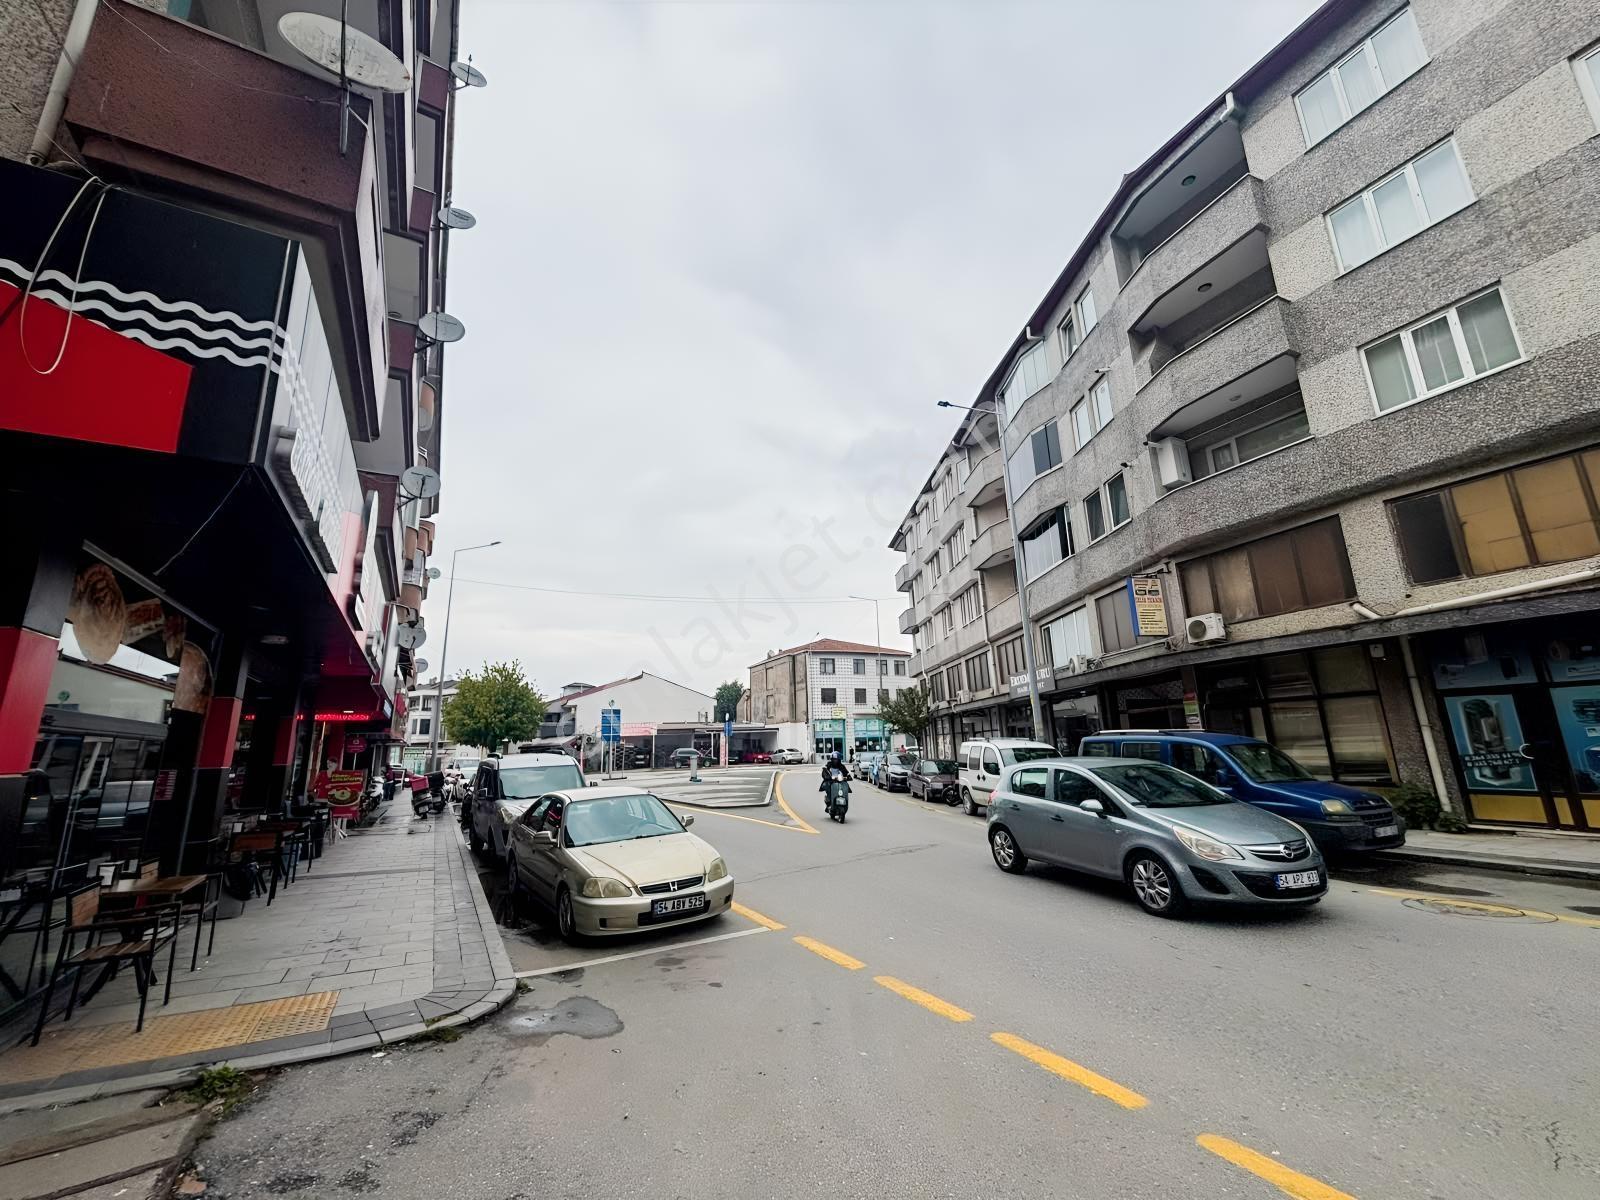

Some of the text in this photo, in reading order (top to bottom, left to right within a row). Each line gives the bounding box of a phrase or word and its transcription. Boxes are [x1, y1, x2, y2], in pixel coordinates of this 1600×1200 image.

[658, 896, 703, 913] 54 ABV 525
